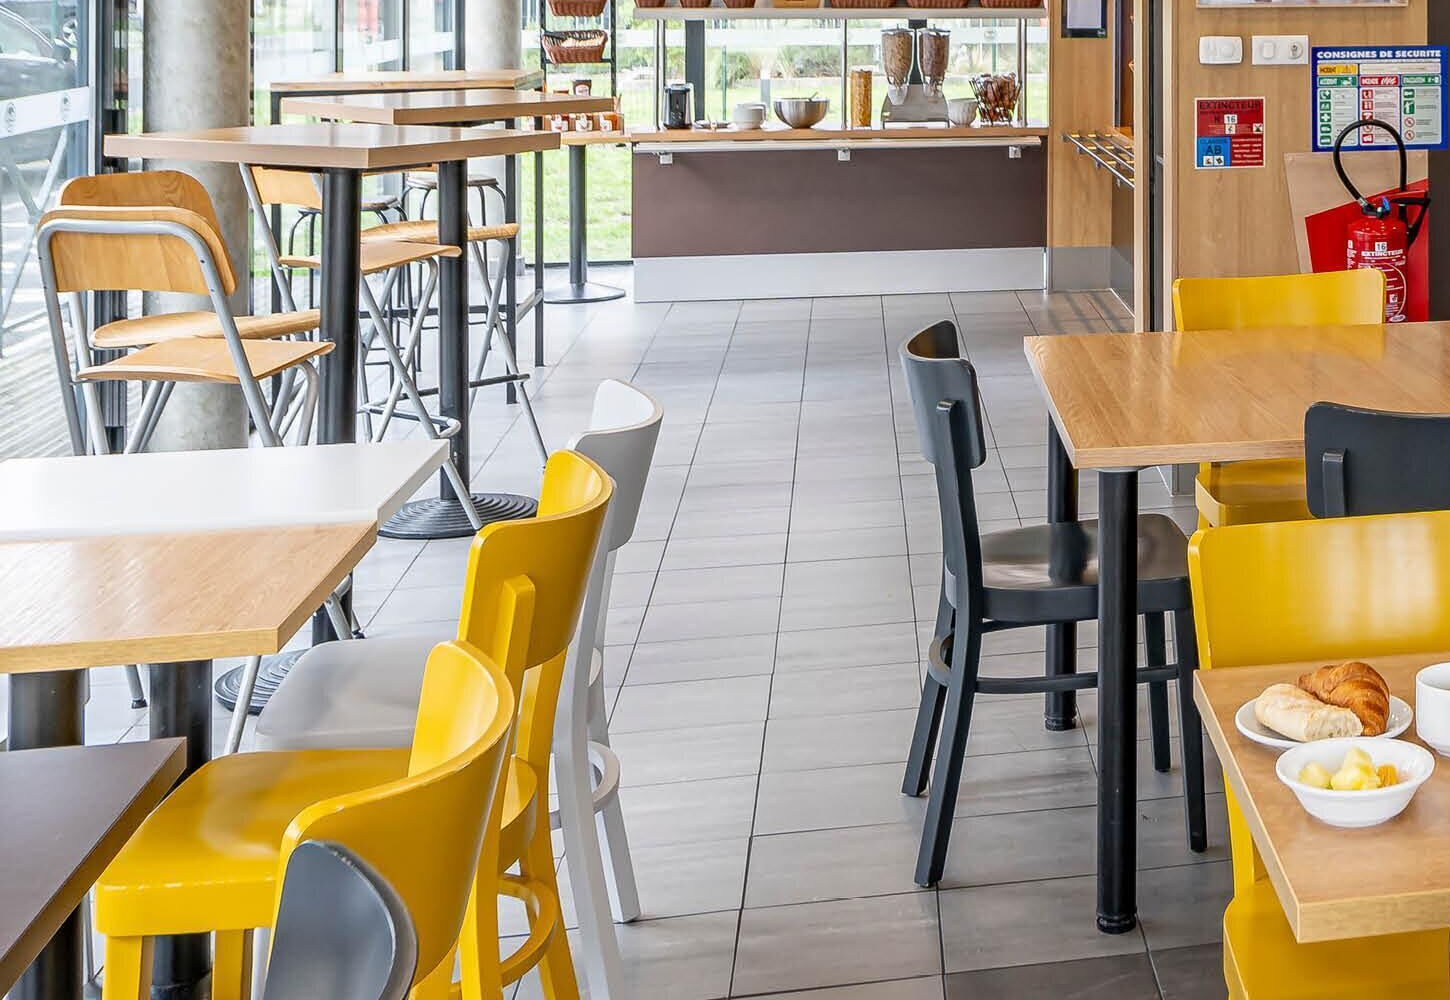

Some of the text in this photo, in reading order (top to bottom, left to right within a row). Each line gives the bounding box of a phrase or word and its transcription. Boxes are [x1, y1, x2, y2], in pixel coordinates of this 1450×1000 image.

[1316, 49, 1442, 59] CONSIGNES DE SECURITE
[1226, 115, 1237, 123] 16
